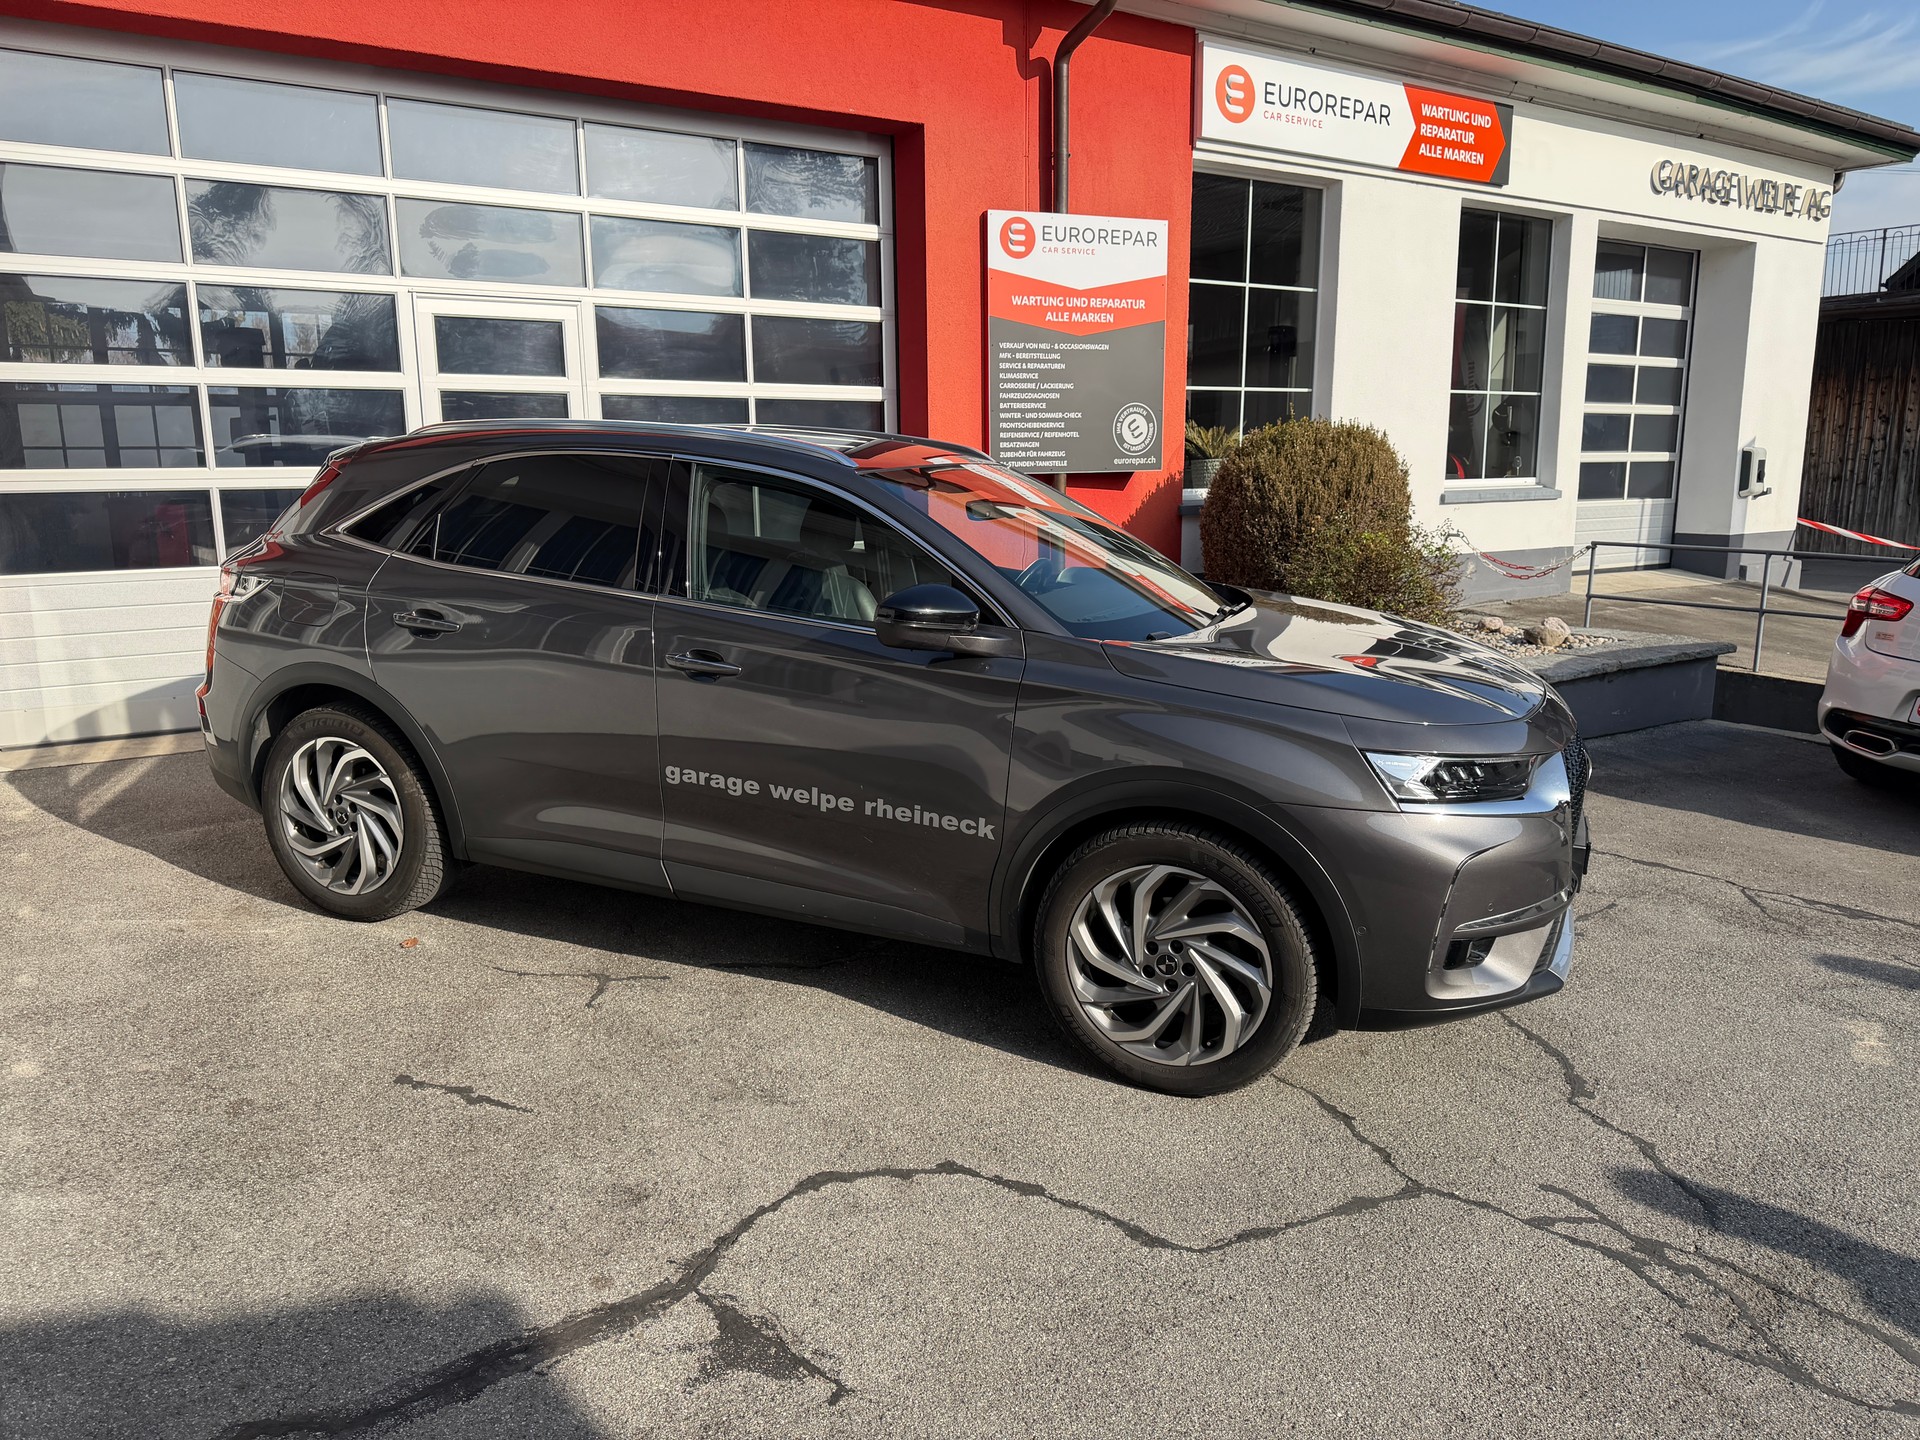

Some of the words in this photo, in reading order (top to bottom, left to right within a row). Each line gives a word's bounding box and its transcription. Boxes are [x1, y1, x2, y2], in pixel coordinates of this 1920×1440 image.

[1264, 82, 1391, 126] EUROREPAR
[1263, 110, 1282, 123] CAR
[1284, 114, 1323, 129] SERVICE
[1421, 103, 1470, 125] WARTUNG
[1471, 112, 1492, 129] UND
[1420, 123, 1475, 145] REPARATUR
[1419, 143, 1442, 158] ALLE
[1443, 146, 1484, 166] MARKEN
[1653, 160, 1739, 204] GARAGE
[1803, 188, 1831, 220] AG
[1042, 226, 1158, 248] EUROREPAR
[1062, 248, 1096, 256] SERVICE
[1012, 295, 1064, 307] WARTUNG
[1066, 296, 1088, 308] UND
[1090, 298, 1146, 309] REPARATUR
[1045, 312, 1069, 322] ALLE
[1072, 312, 1114, 323] MARKEN
[1119, 407, 1147, 422] VERTRAUEN
[1114, 456, 1156, 466] eurorepar.ch
[664, 765, 760, 796] garage
[768, 783, 854, 812] welpe
[864, 798, 996, 840] rheineck
